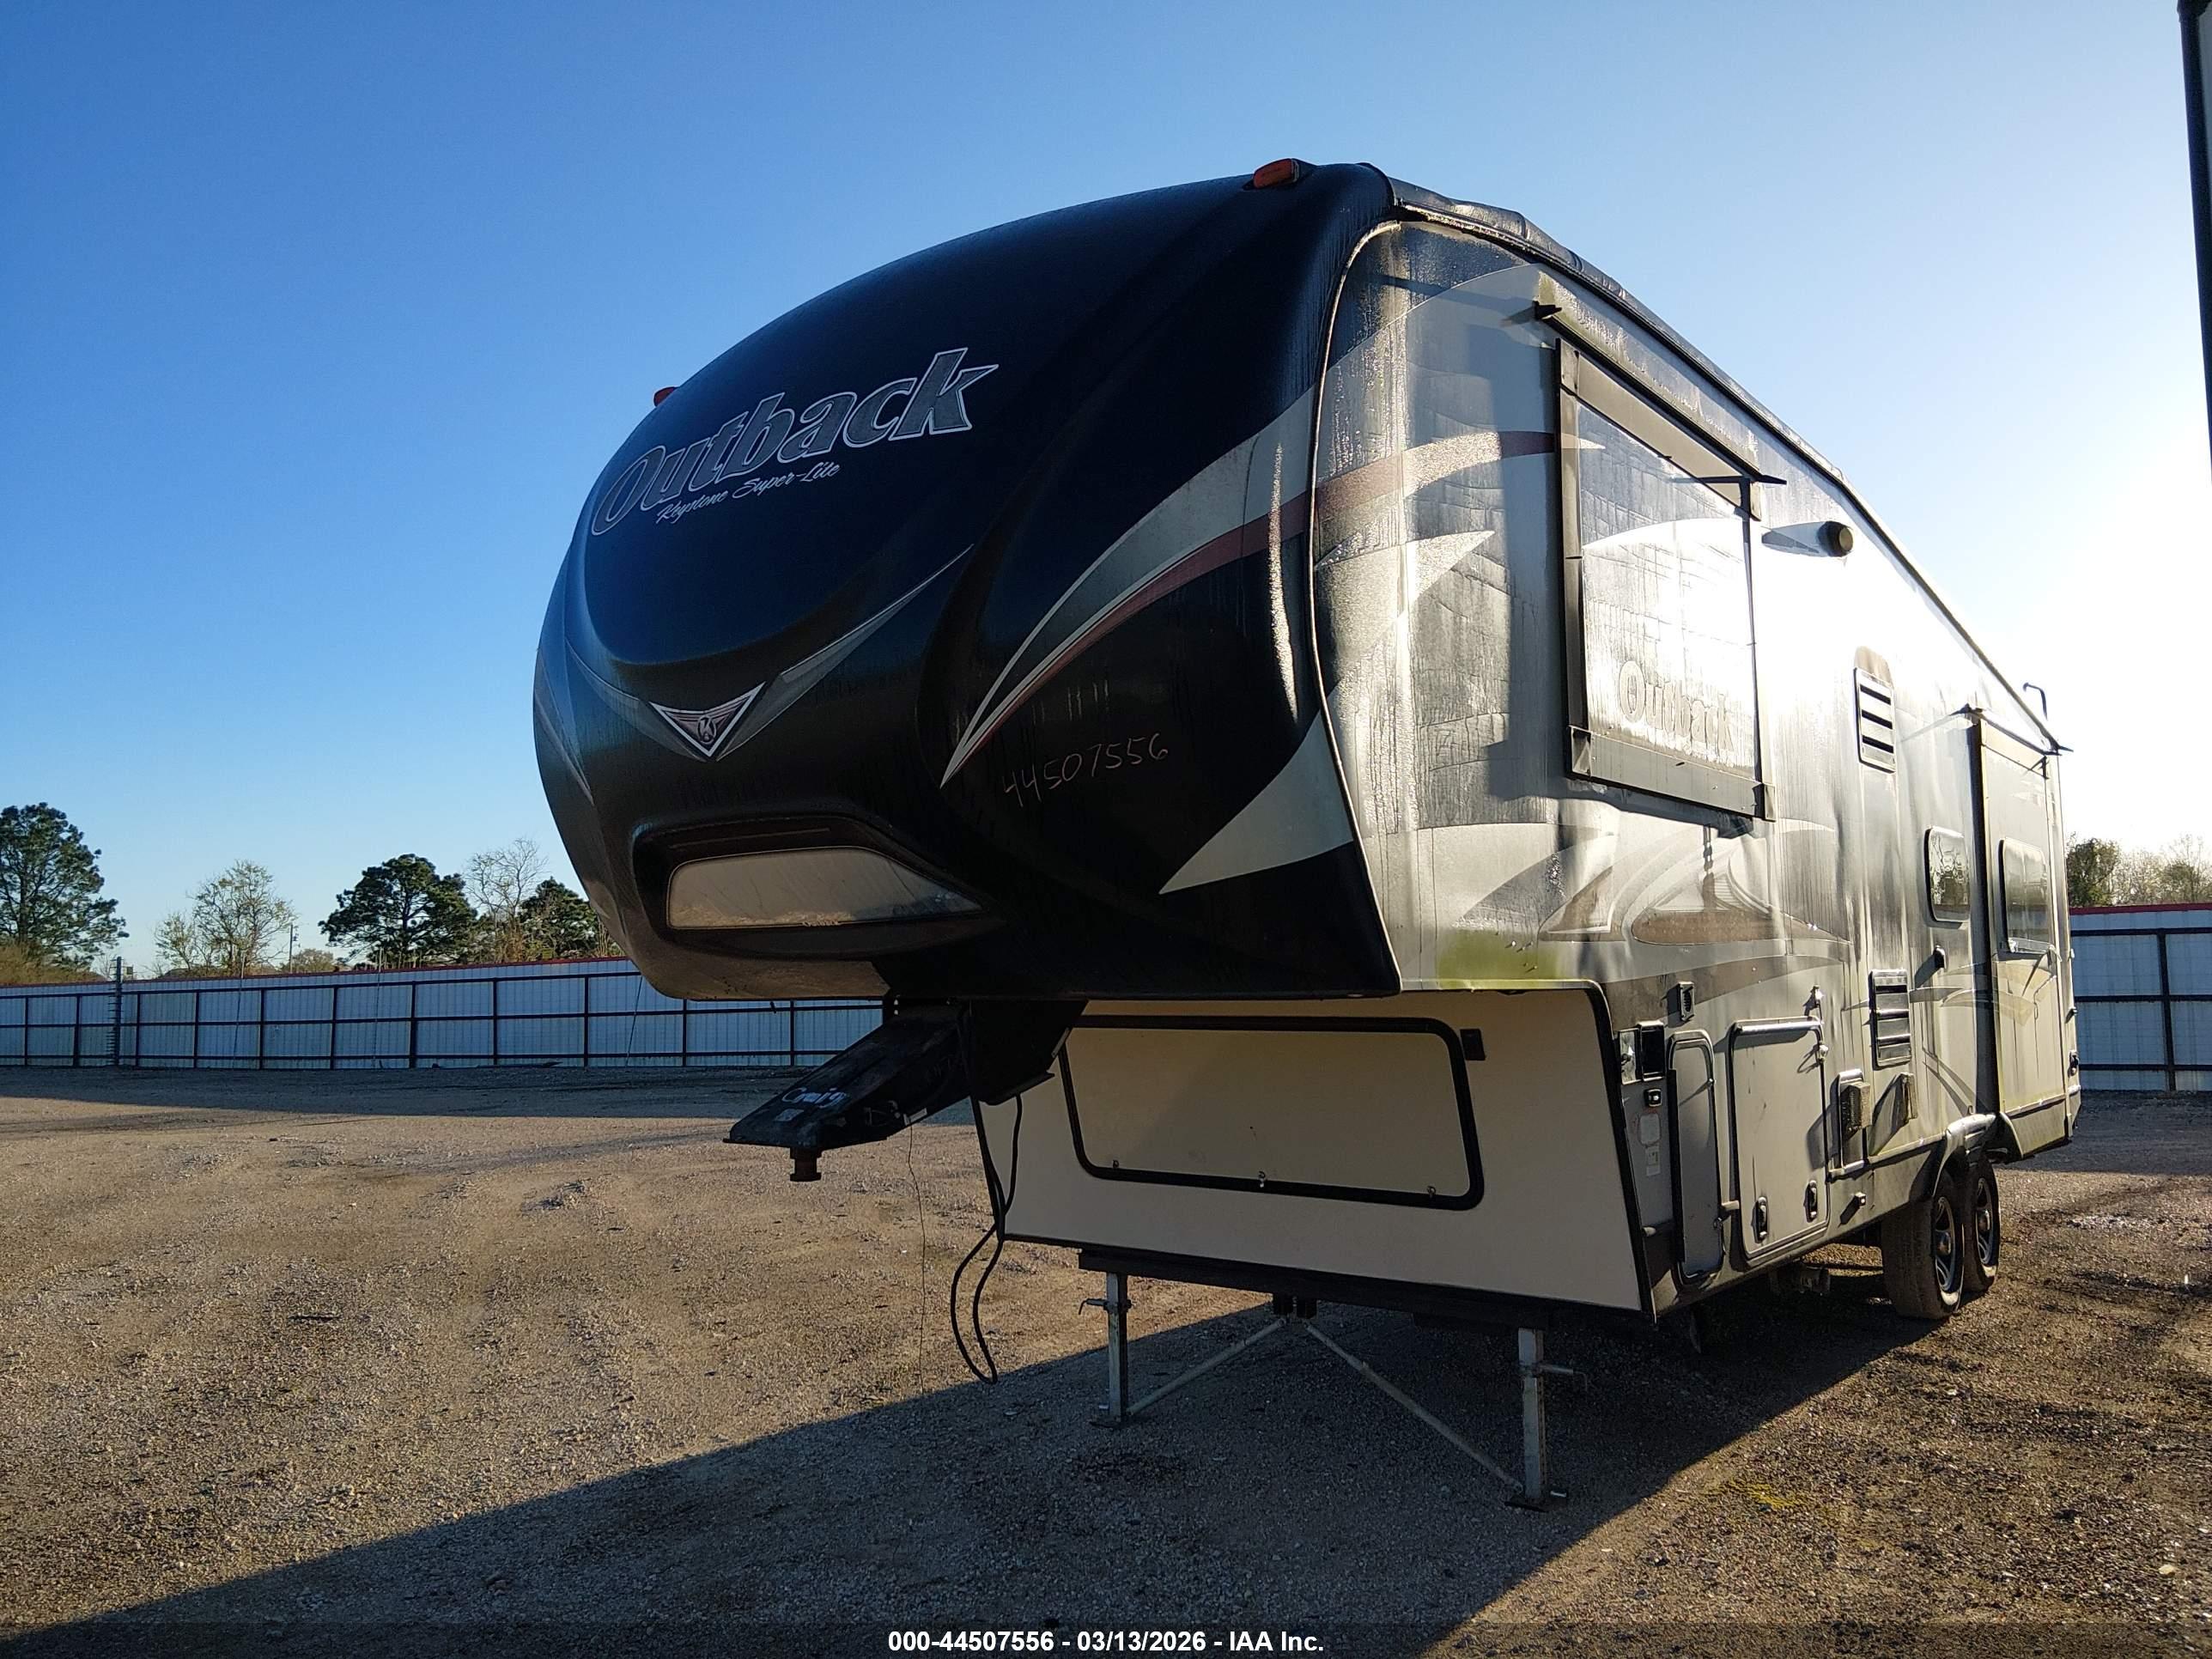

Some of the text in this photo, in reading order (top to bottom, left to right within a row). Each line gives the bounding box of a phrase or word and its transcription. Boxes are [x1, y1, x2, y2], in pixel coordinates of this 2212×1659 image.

[591, 347, 1000, 536] Outback
[656, 462, 840, 525] Keystone Super-Lite
[1618, 659, 1735, 753] Outback
[1002, 732, 1169, 808] 44507556
